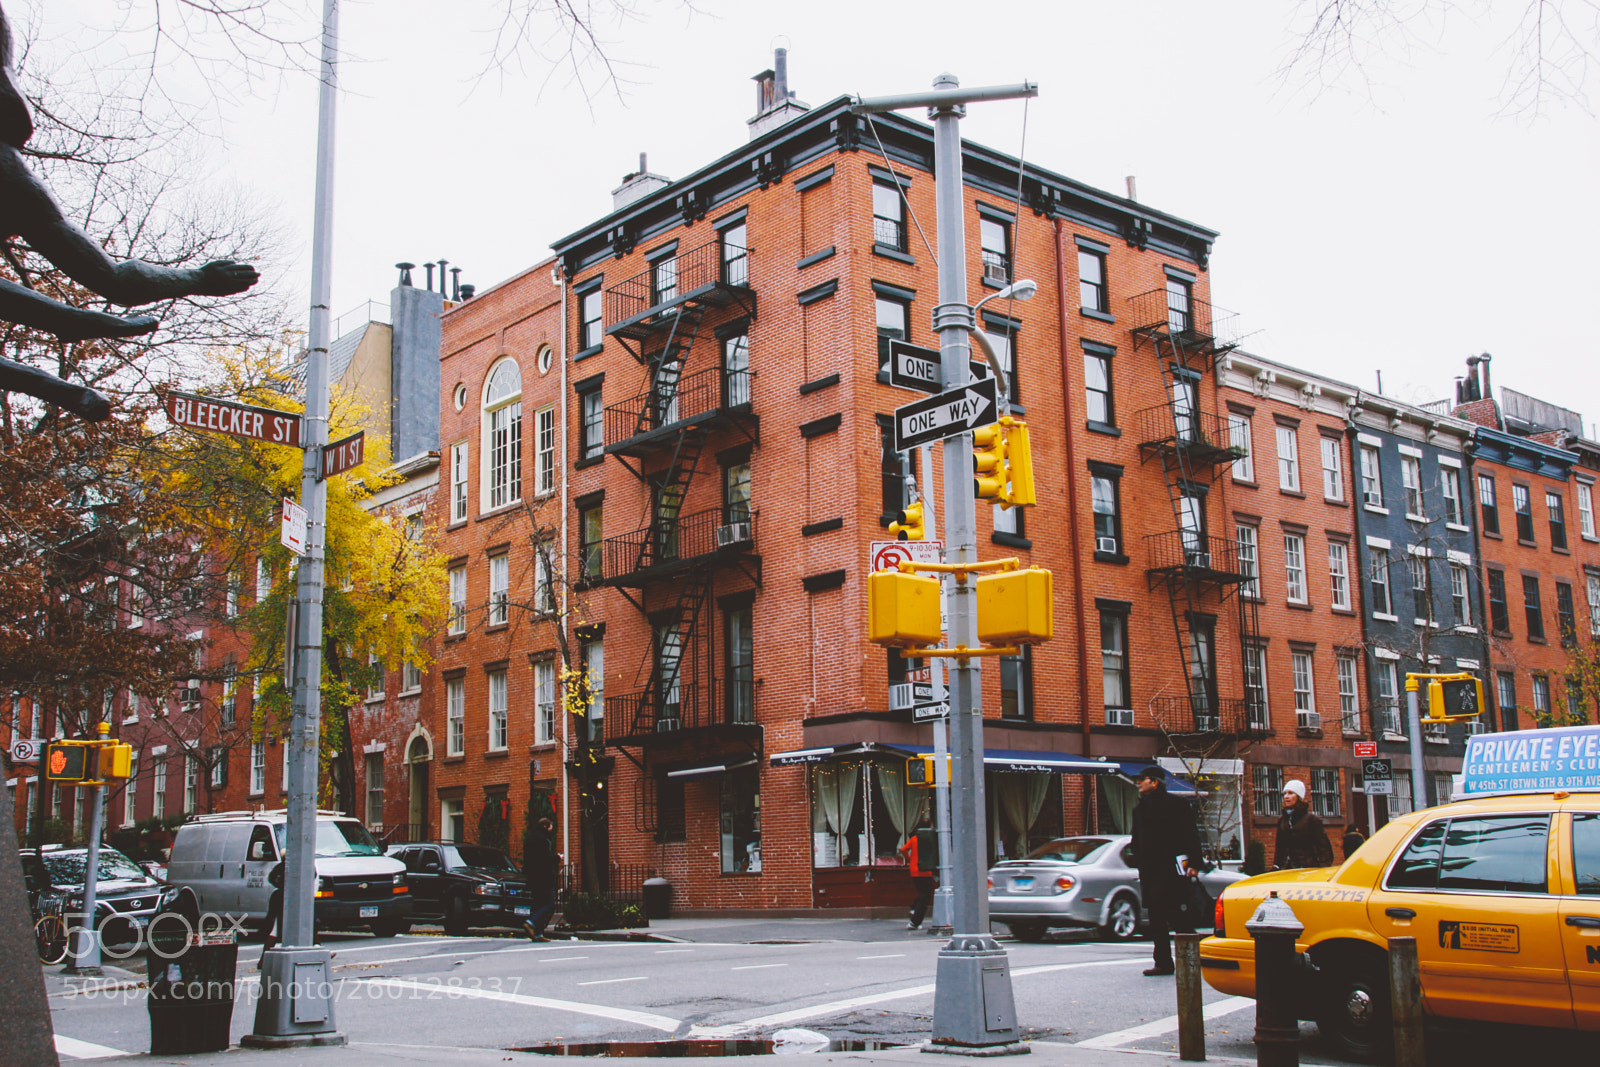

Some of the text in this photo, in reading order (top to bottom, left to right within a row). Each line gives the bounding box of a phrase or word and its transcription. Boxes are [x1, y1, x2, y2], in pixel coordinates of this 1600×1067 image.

[906, 359, 933, 380] ONE
[174, 397, 293, 443] BLEECKER ST
[909, 397, 980, 433] ONE WAY
[326, 438, 361, 474] W 11 ST
[922, 669, 930, 679] ST
[918, 708, 930, 716] ONE
[1471, 735, 1600, 763] PRIVATE EYE
[1469, 758, 1600, 775] GENTLEMEN'S CLU
[1468, 781, 1476, 791] W
[1478, 779, 1496, 791] 45th
[1498, 779, 1508, 790] ST
[1510, 778, 1537, 790] (BTWN
[1539, 777, 1555, 788] 8TH
[1557, 776, 1564, 787] &
[1566, 775, 1583, 787] 9TH
[1331, 890, 1366, 902] 7Y15
